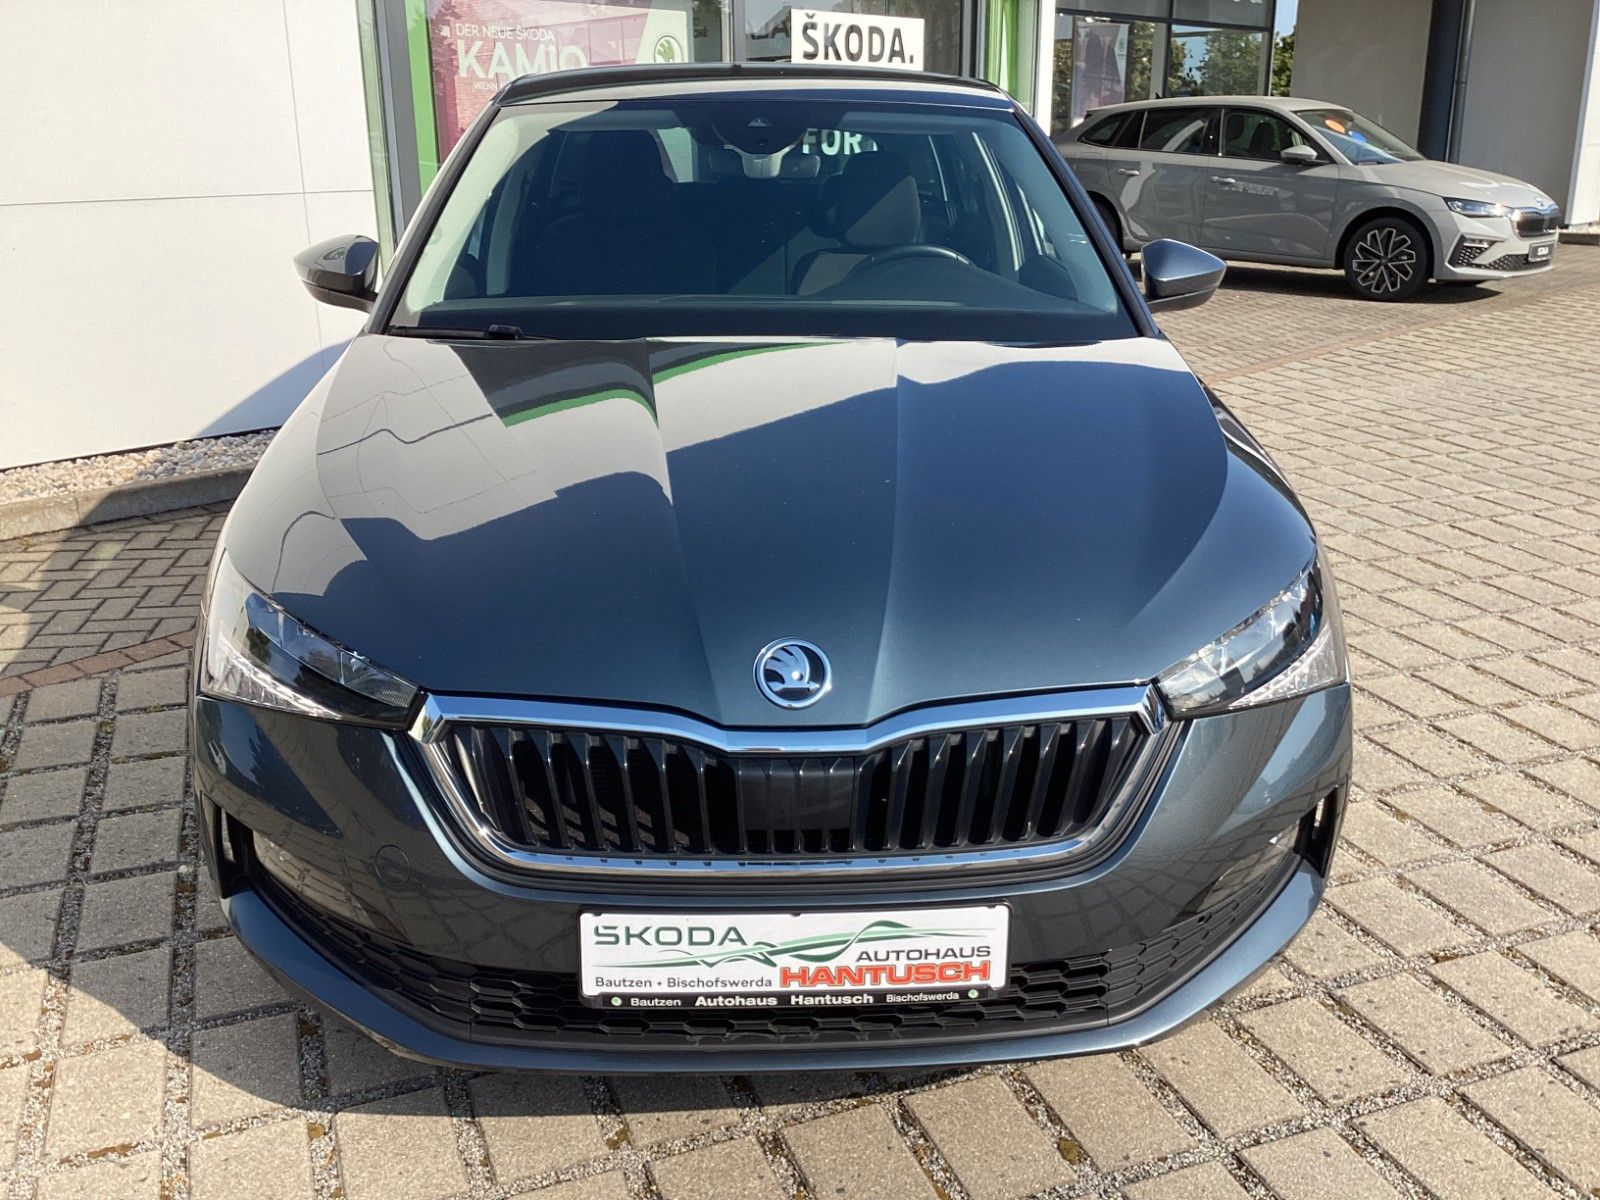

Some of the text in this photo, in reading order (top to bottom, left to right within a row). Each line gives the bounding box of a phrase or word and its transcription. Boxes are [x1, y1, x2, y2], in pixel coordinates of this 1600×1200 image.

[455, 23, 555, 41] DER NEUE ŠKODA
[856, 946, 991, 962] AUTOHAUS
[595, 976, 772, 988] Bautzen Bischofswerda
[779, 960, 991, 988] HANTUSCH
[630, 991, 960, 1007] Bautzen Autohaus Hantusch Bischofswerda
